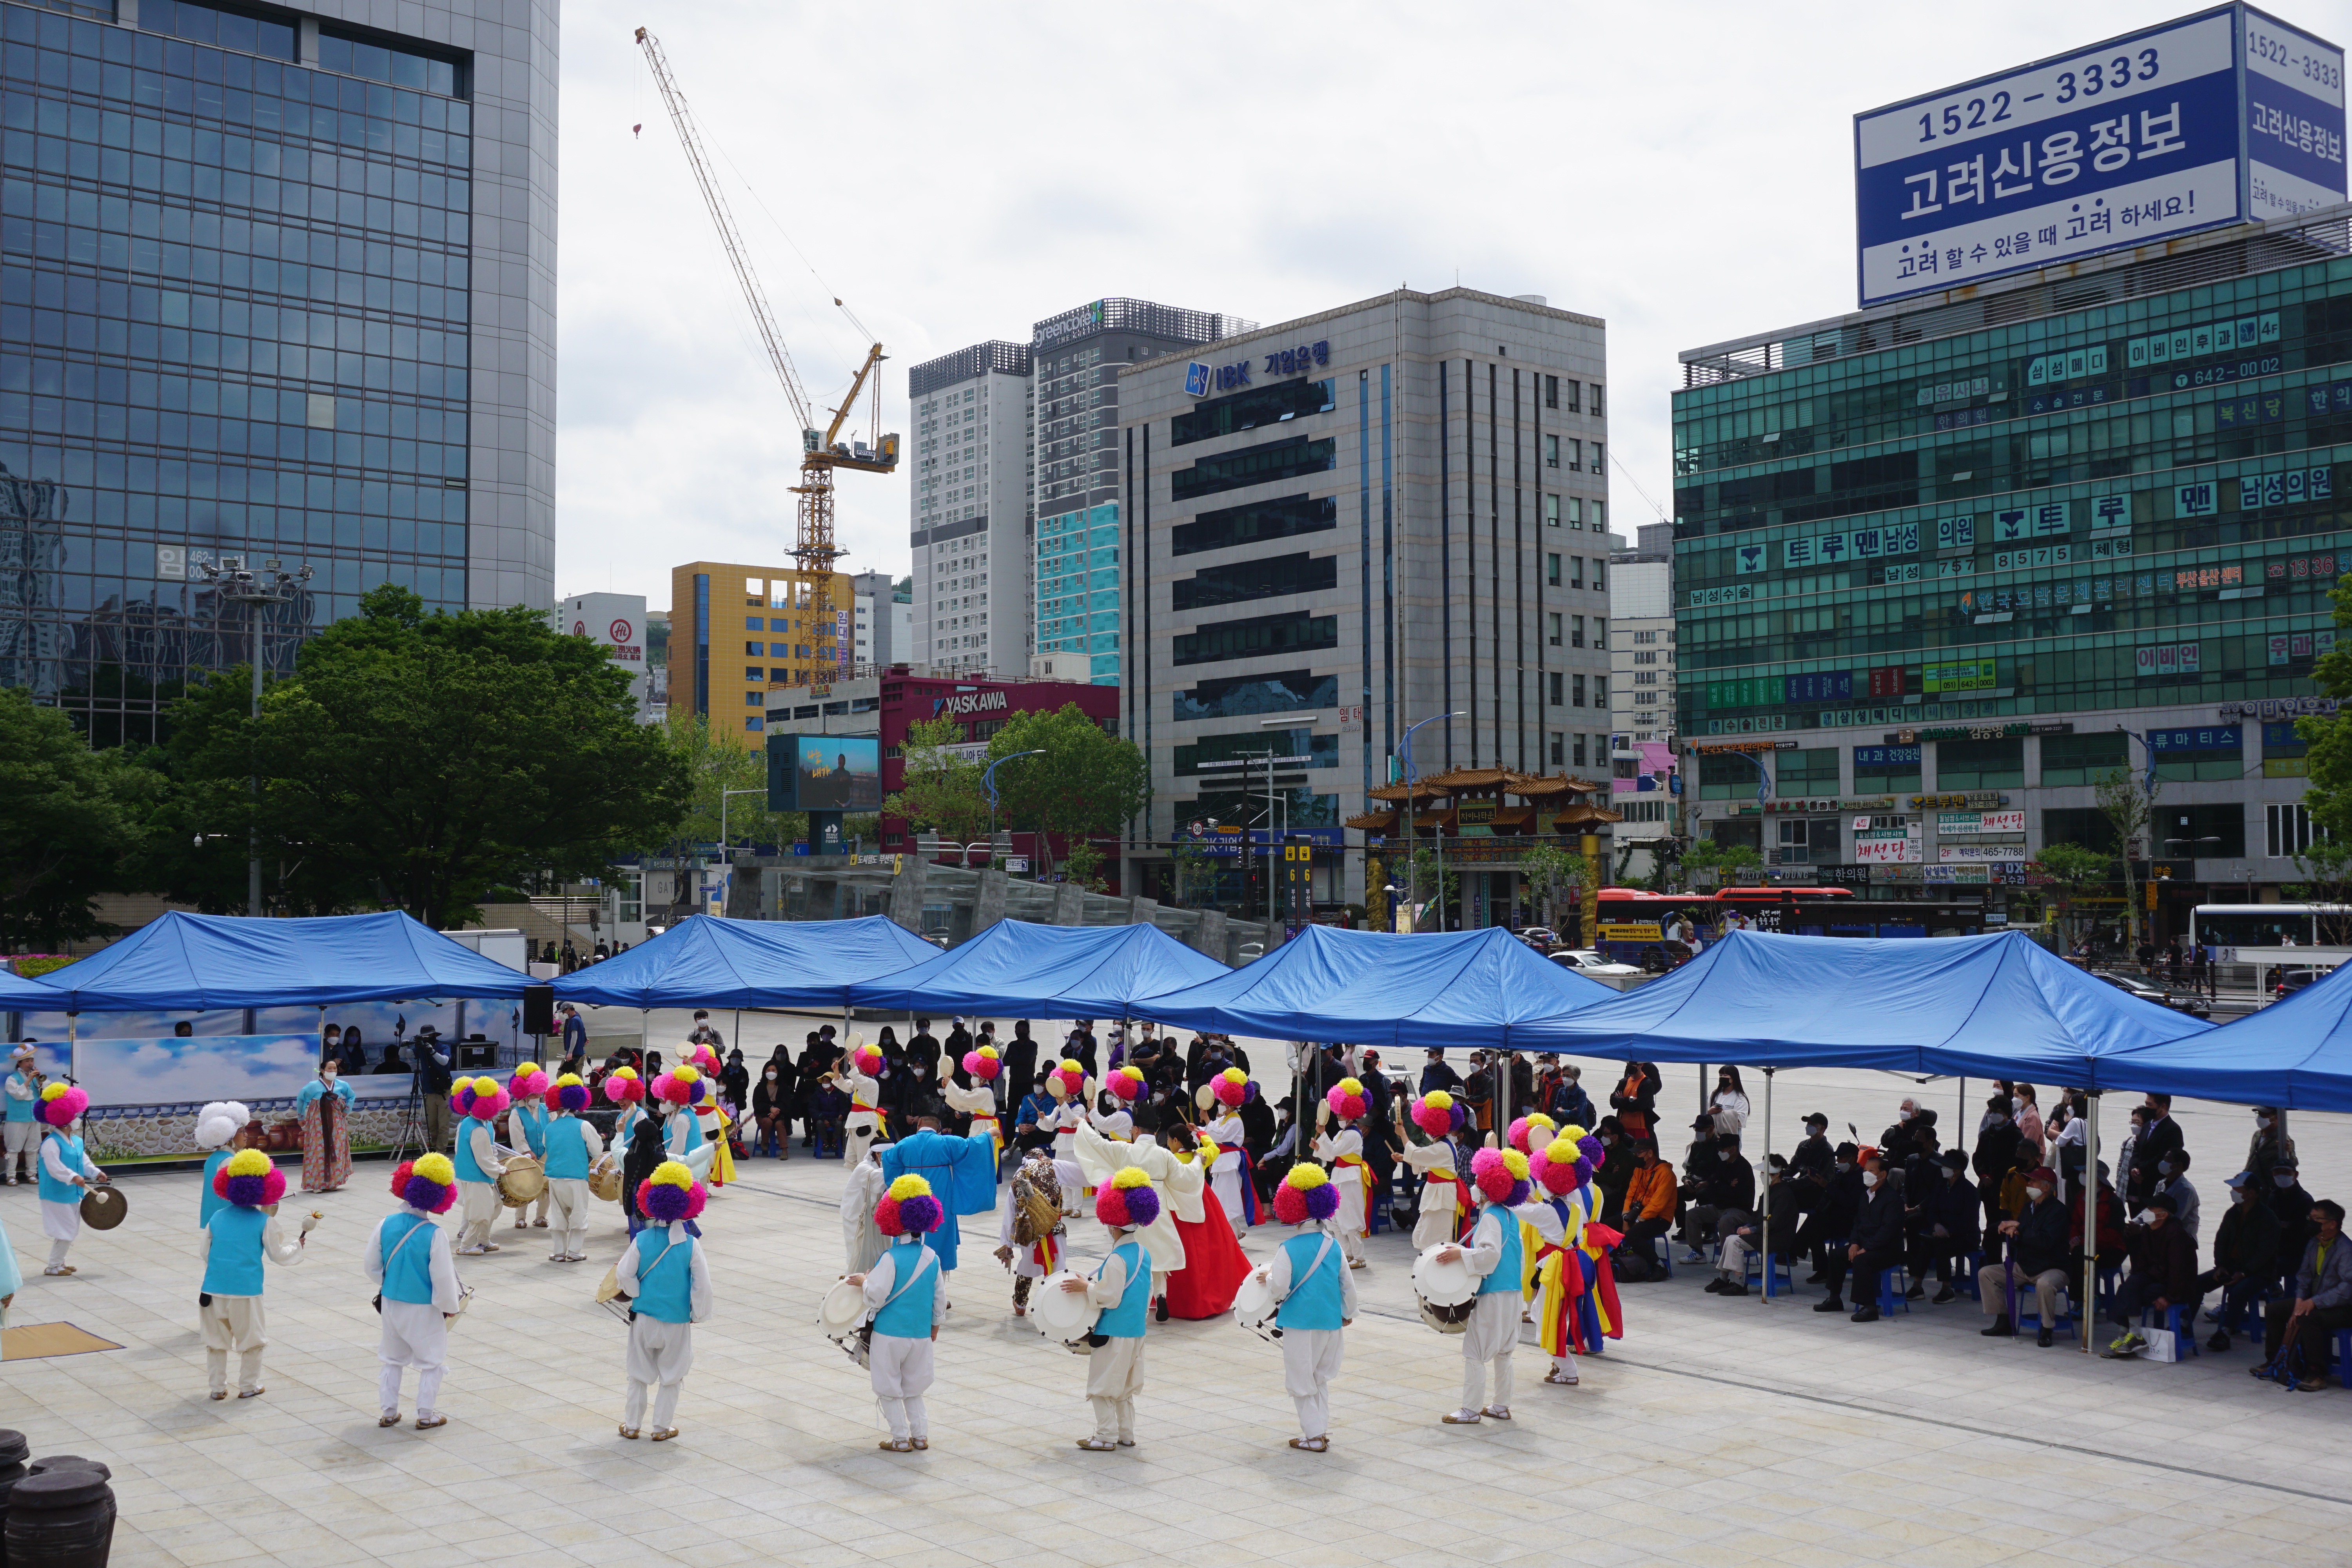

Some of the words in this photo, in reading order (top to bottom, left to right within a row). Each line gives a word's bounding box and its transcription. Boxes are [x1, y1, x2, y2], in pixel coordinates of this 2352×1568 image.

[2249, 31, 2339, 90] 1522-3333
[1919, 48, 2160, 143] 1522-3333
[2252, 101, 2342, 164] 고려신용정보
[1901, 102, 2186, 220] 고려신용정보
[2252, 184, 2267, 204] 고려
[2270, 192, 2276, 207] 할
[2278, 197, 2284, 209] 수
[2286, 199, 2298, 214] 있을
[1897, 247, 1938, 281] 고려
[1946, 248, 1964, 269] 할
[1971, 243, 1988, 265] 수
[1994, 232, 2031, 257] 있을
[2039, 224, 2057, 247] 때
[2065, 206, 2112, 242] 고려
[2120, 190, 2196, 227] 하세요!
[1035, 312, 1092, 349] greencore
[1056, 335, 1070, 345] THE
[1074, 328, 1092, 339] CITY
[2032, 352, 2106, 379] 삼성메디
[2132, 329, 2230, 362] 이비인후과
[2261, 321, 2278, 336] 4F
[1216, 360, 1250, 390] IBK
[1264, 340, 1330, 376] 기업은행
[2195, 358, 2280, 385] 642-0002
[1936, 378, 1989, 401] 유사나
[2033, 390, 2104, 411] 수술전문
[1938, 408, 1987, 429] 한의원
[2220, 398, 2281, 423] 복신당
[2241, 468, 2331, 506] 남성의원
[1788, 530, 1878, 563] 트루맨
[1885, 518, 1973, 553] 남성의원
[2095, 539, 2131, 556] 체형
[189, 550, 214, 563] 462-
[1939, 559, 1974, 573] 757
[1999, 548, 2067, 567] 8575
[1887, 566, 1918, 581] 남성
[2290, 556, 2334, 577] 1336
[1692, 586, 1751, 604] 남성수술
[1977, 572, 2173, 612] 한국도박문제관리센터
[2176, 566, 2242, 588] 부산울산센터
[615, 623, 627, 637] Hi
[838, 612, 848, 639] 임대
[1961, 679, 1994, 688] 642-0002
[946, 691, 1008, 714] YASKAWA
[1711, 687, 1717, 702] 비염
[1339, 704, 1363, 723] 임대
[1840, 708, 1901, 724] 삼성메디
[1910, 702, 1994, 720] 이비인후과
[1726, 716, 1783, 731] 수술전문
[1922, 726, 1967, 741] 류마부산
[2155, 731, 2234, 749] 류마티스
[807, 748, 822, 765] 나는
[1701, 740, 1775, 755] 한국도박문제관리센터
[1858, 750, 1884, 762] 내과
[1889, 748, 1920, 761] 건강검진
[812, 764, 831, 779] 내가
[1925, 795, 1965, 808] 트루맨
[1461, 811, 1494, 821] 차이나타운
[1939, 813, 1980, 822] 월남쌈&샤브샤브
[1982, 813, 2023, 829] 채선당
[1857, 841, 1905, 860] 채선당
[1959, 848, 1980, 857] 예약문의
[1983, 848, 2024, 857] 465-7788
[857, 855, 878, 865] 도시철도
[879, 854, 895, 864] 부산역
[893, 853, 903, 876] 6
[1925, 866, 1955, 875] 삼성메디
[2153, 866, 2172, 877] 한솥
[1290, 869, 1296, 882] 6
[1304, 869, 1310, 882] 6
[1780, 871, 1809, 879] YOUNG
[1835, 867, 1866, 882] 한의원
